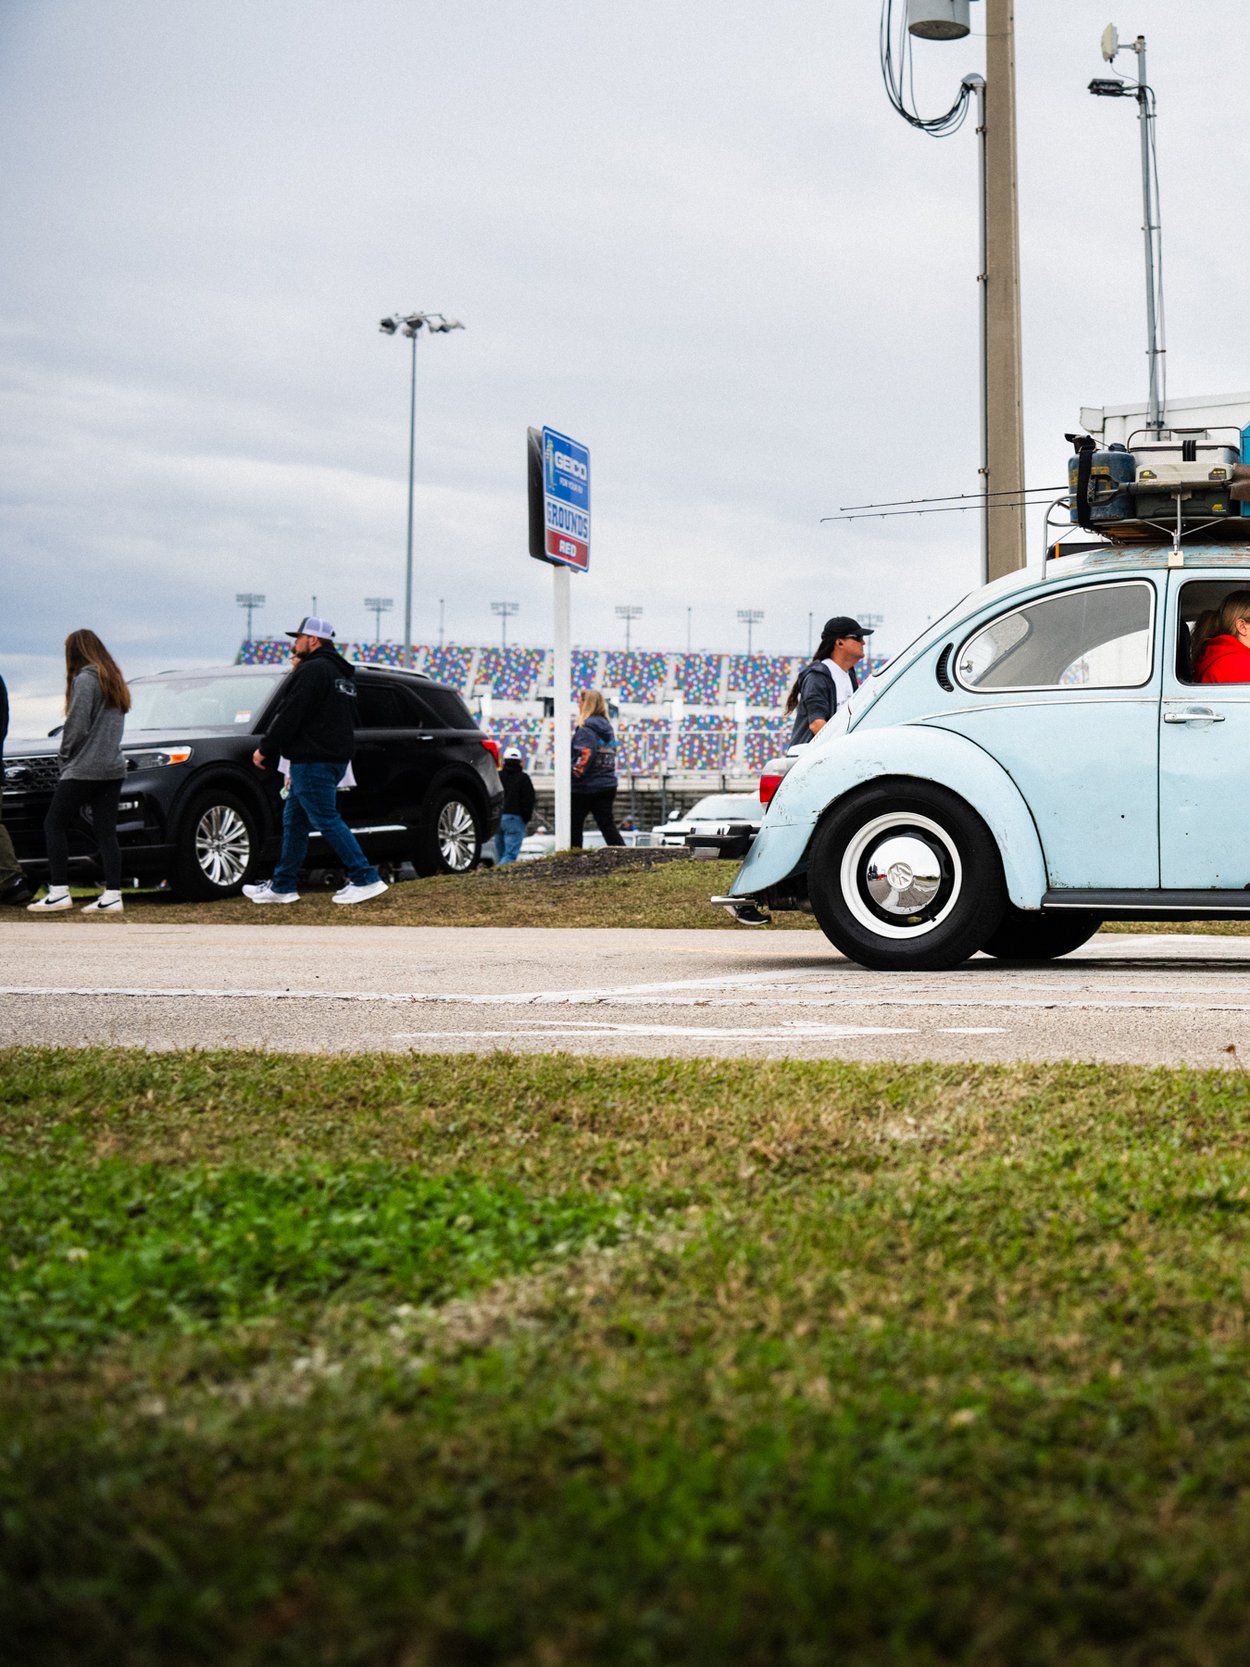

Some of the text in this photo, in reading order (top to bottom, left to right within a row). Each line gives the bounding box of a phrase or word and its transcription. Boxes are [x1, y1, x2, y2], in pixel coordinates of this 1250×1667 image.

[554, 451, 588, 481] GEICO
[546, 502, 588, 539] GROUNDS
[559, 538, 577, 558] RED
